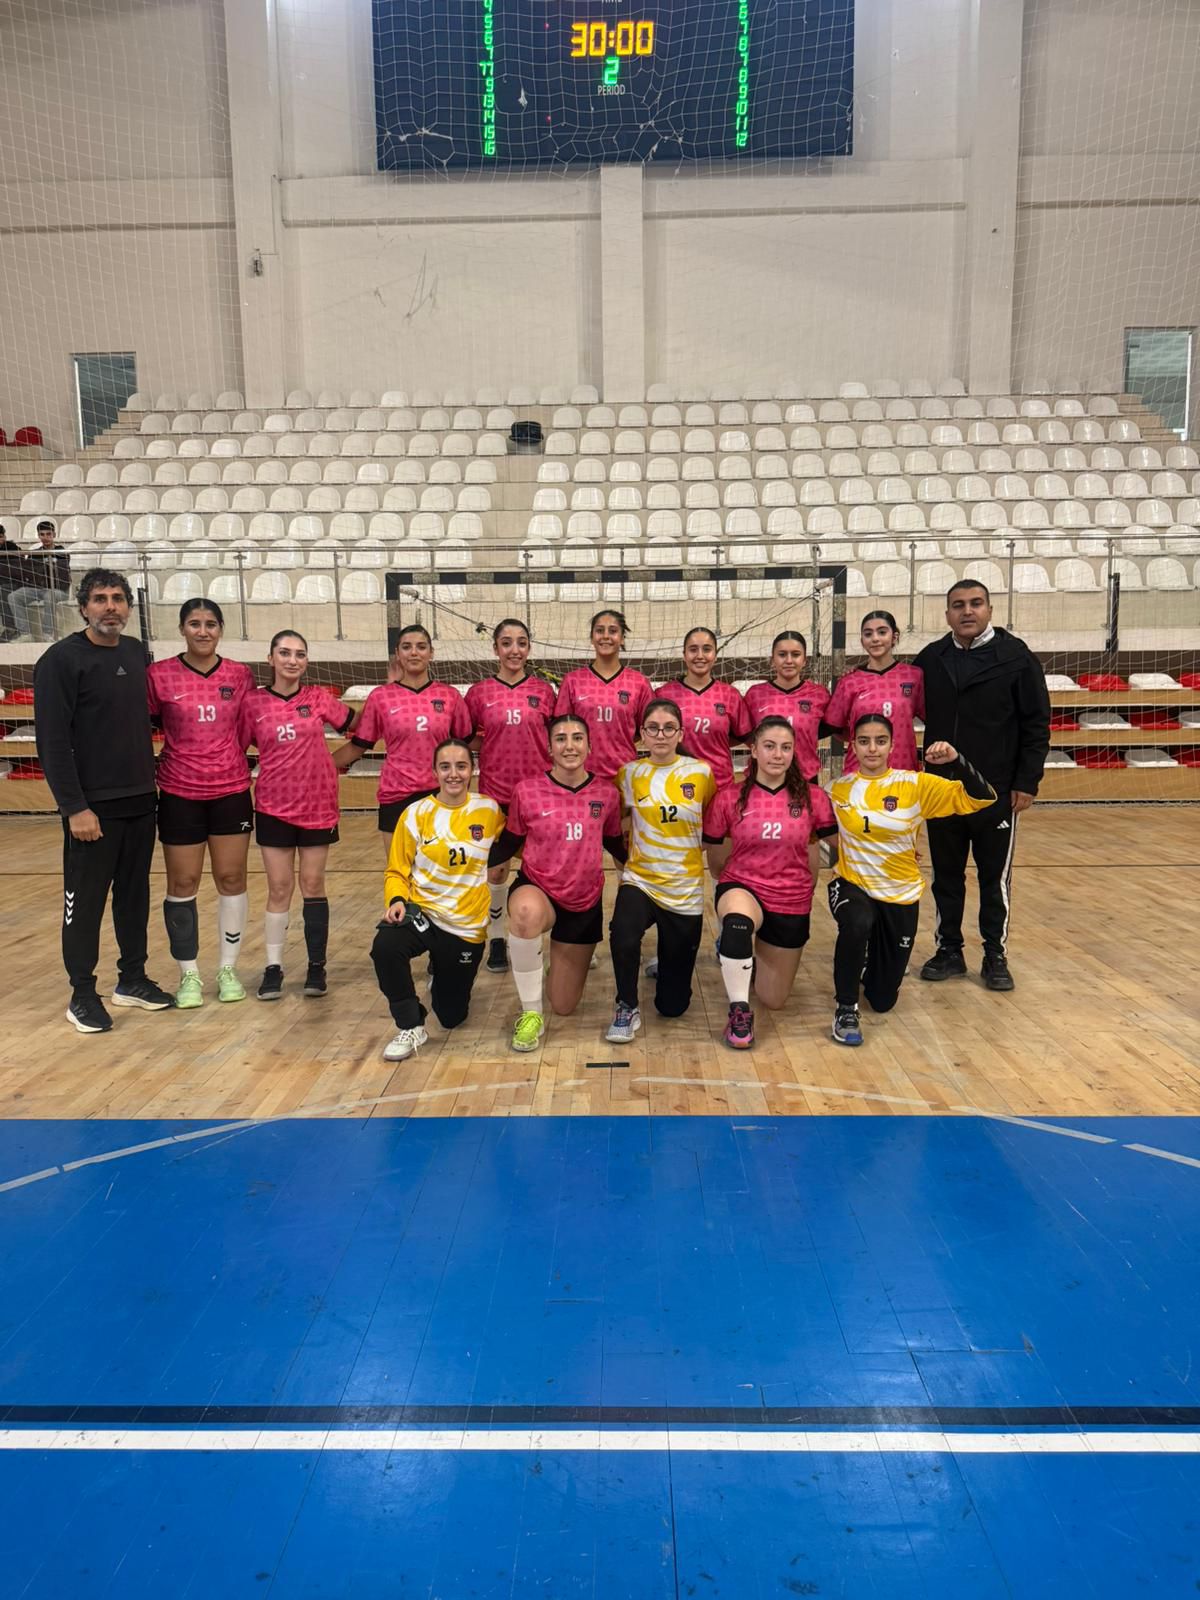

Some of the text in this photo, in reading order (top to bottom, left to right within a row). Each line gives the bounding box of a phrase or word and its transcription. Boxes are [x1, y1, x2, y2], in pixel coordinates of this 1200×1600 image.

[740, 20, 748, 35] 7
[571, 21, 654, 57] 30:00
[485, 45, 493, 60] 7
[740, 52, 748, 67] 7
[604, 57, 620, 85] 2
[597, 84, 626, 96] PERIOD
[736, 100, 748, 115] 10
[736, 116, 748, 130] 11
[197, 704, 216, 722] 13
[506, 709, 522, 725] 15
[596, 706, 613, 722] 10
[882, 701, 892, 717] 8
[416, 715, 428, 731] 2
[694, 717, 711, 733] 72
[277, 724, 296, 742] 25
[659, 805, 678, 823] 12
[565, 822, 583, 841] 18
[761, 822, 782, 840] 22
[862, 815, 871, 834] 1
[448, 847, 467, 866] 21
